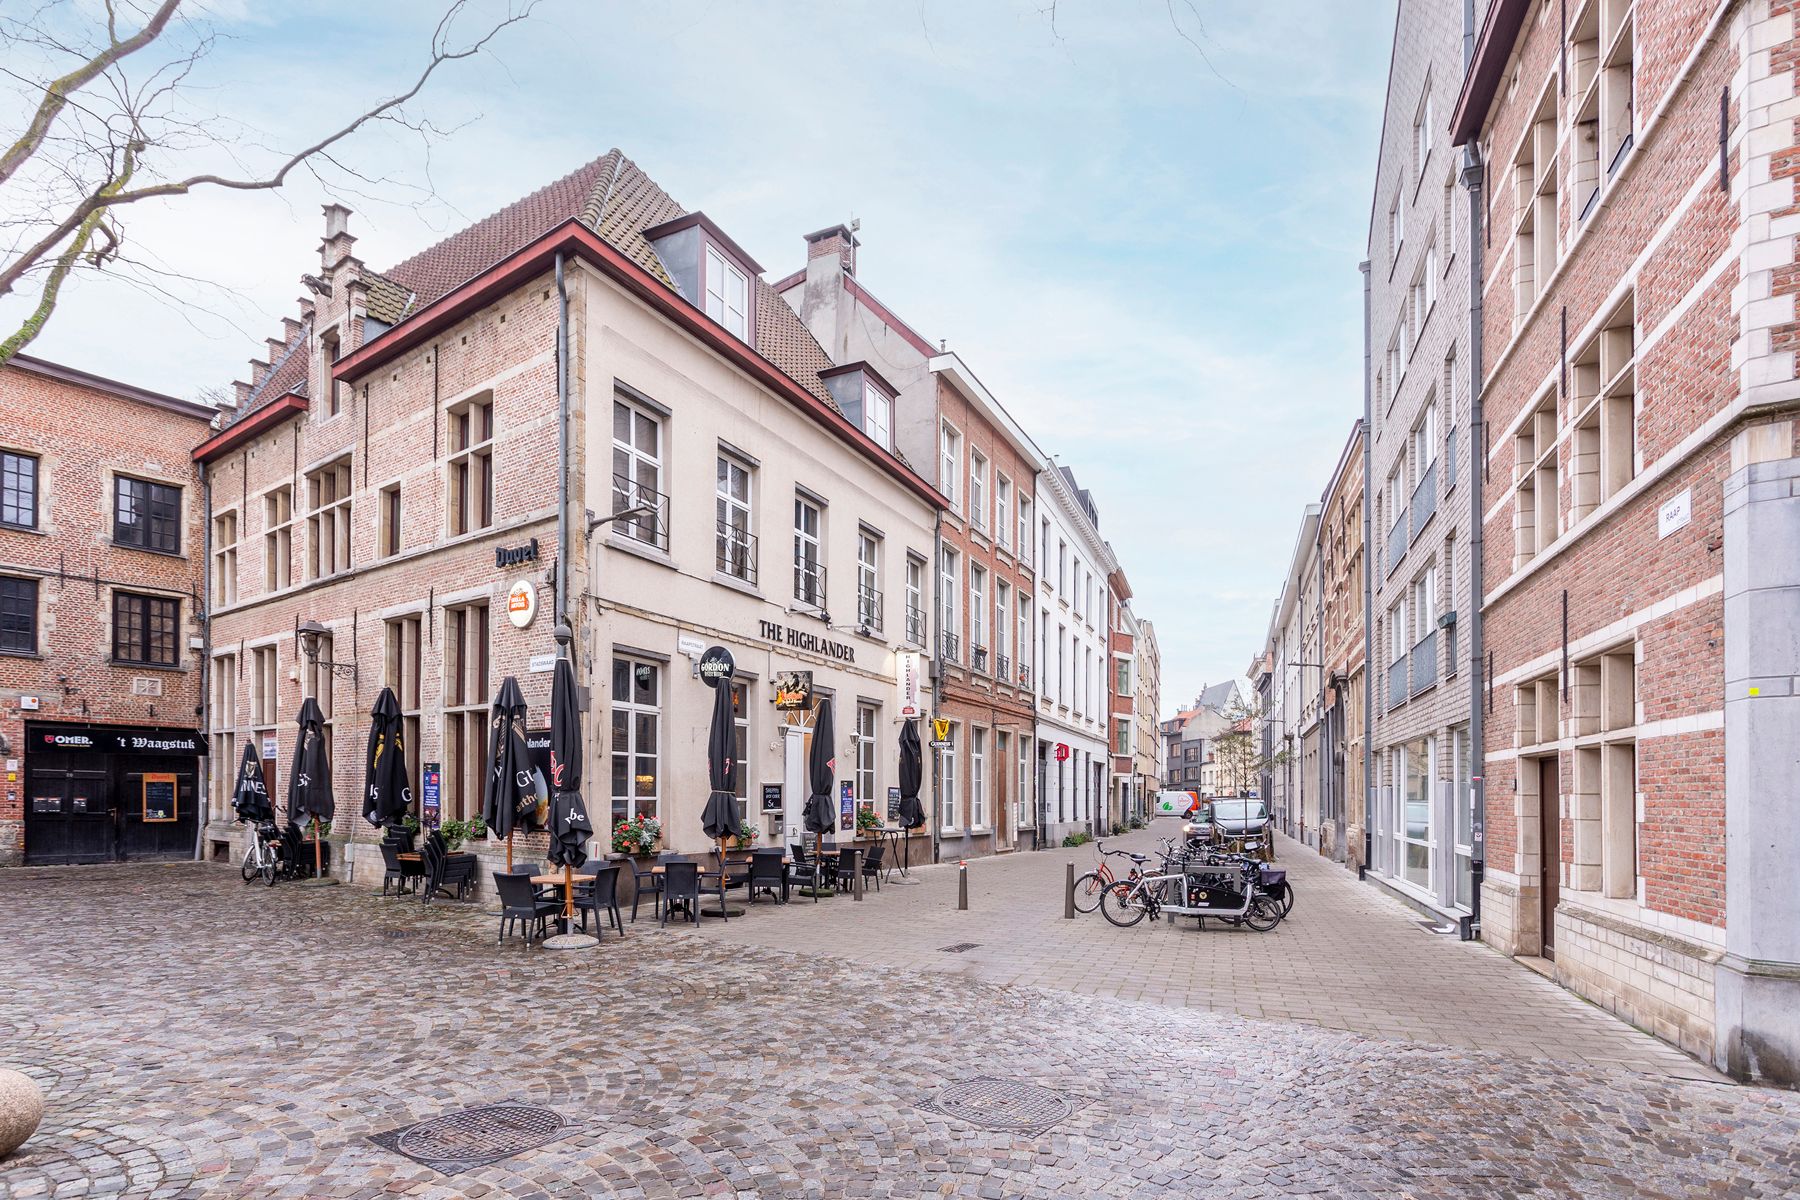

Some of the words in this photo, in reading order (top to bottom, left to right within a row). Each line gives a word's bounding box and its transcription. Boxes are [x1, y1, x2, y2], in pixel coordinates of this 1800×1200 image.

[1665, 506, 1680, 522] RAAP
[496, 538, 539, 568] Duvel
[759, 619, 783, 642] THE
[787, 627, 855, 663] HIGHLANDER
[700, 663, 730, 672] GORDON
[132, 737, 195, 751] Waagstuk
